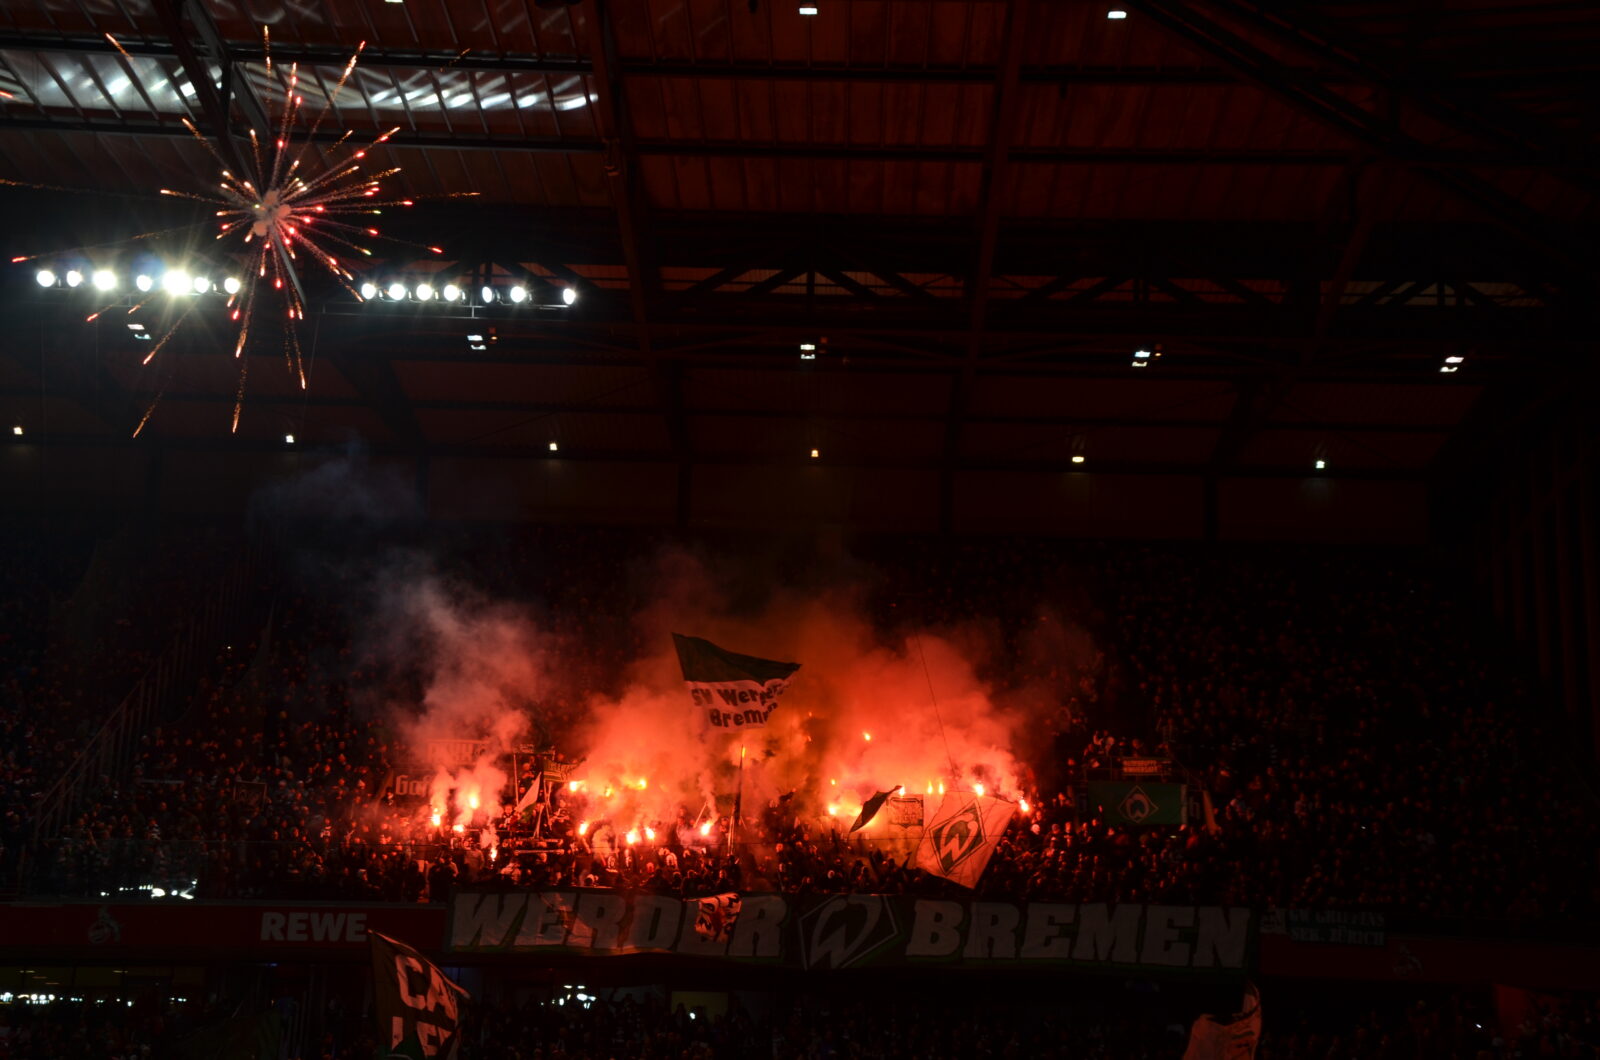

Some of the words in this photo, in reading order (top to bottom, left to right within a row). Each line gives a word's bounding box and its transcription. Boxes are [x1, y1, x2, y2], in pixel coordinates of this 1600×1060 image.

[691, 688, 713, 706] SV
[260, 912, 367, 942] REWE
[905, 899, 1251, 968] BREMEN
